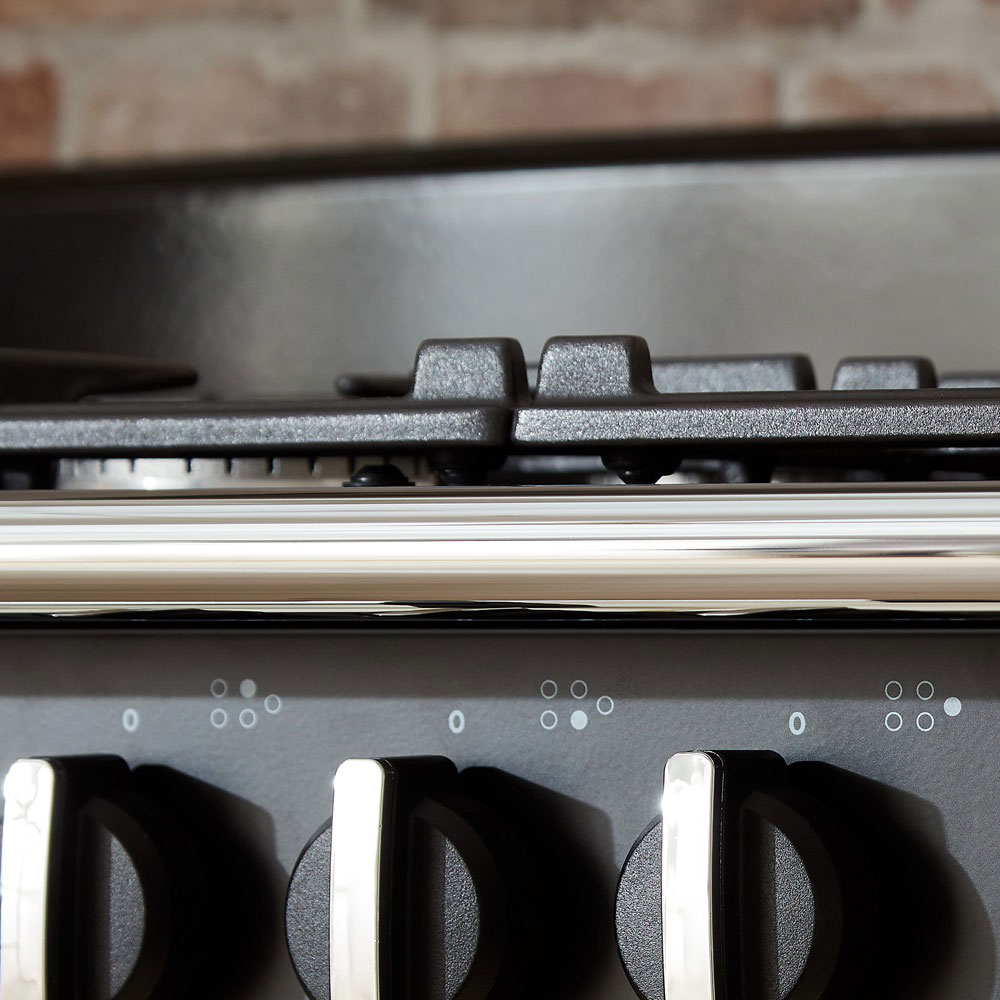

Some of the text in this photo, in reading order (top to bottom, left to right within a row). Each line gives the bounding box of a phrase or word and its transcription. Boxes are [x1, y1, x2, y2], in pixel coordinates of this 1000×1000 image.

[121, 707, 141, 734] 0
[447, 709, 466, 735] 0
[787, 711, 807, 737] 0
